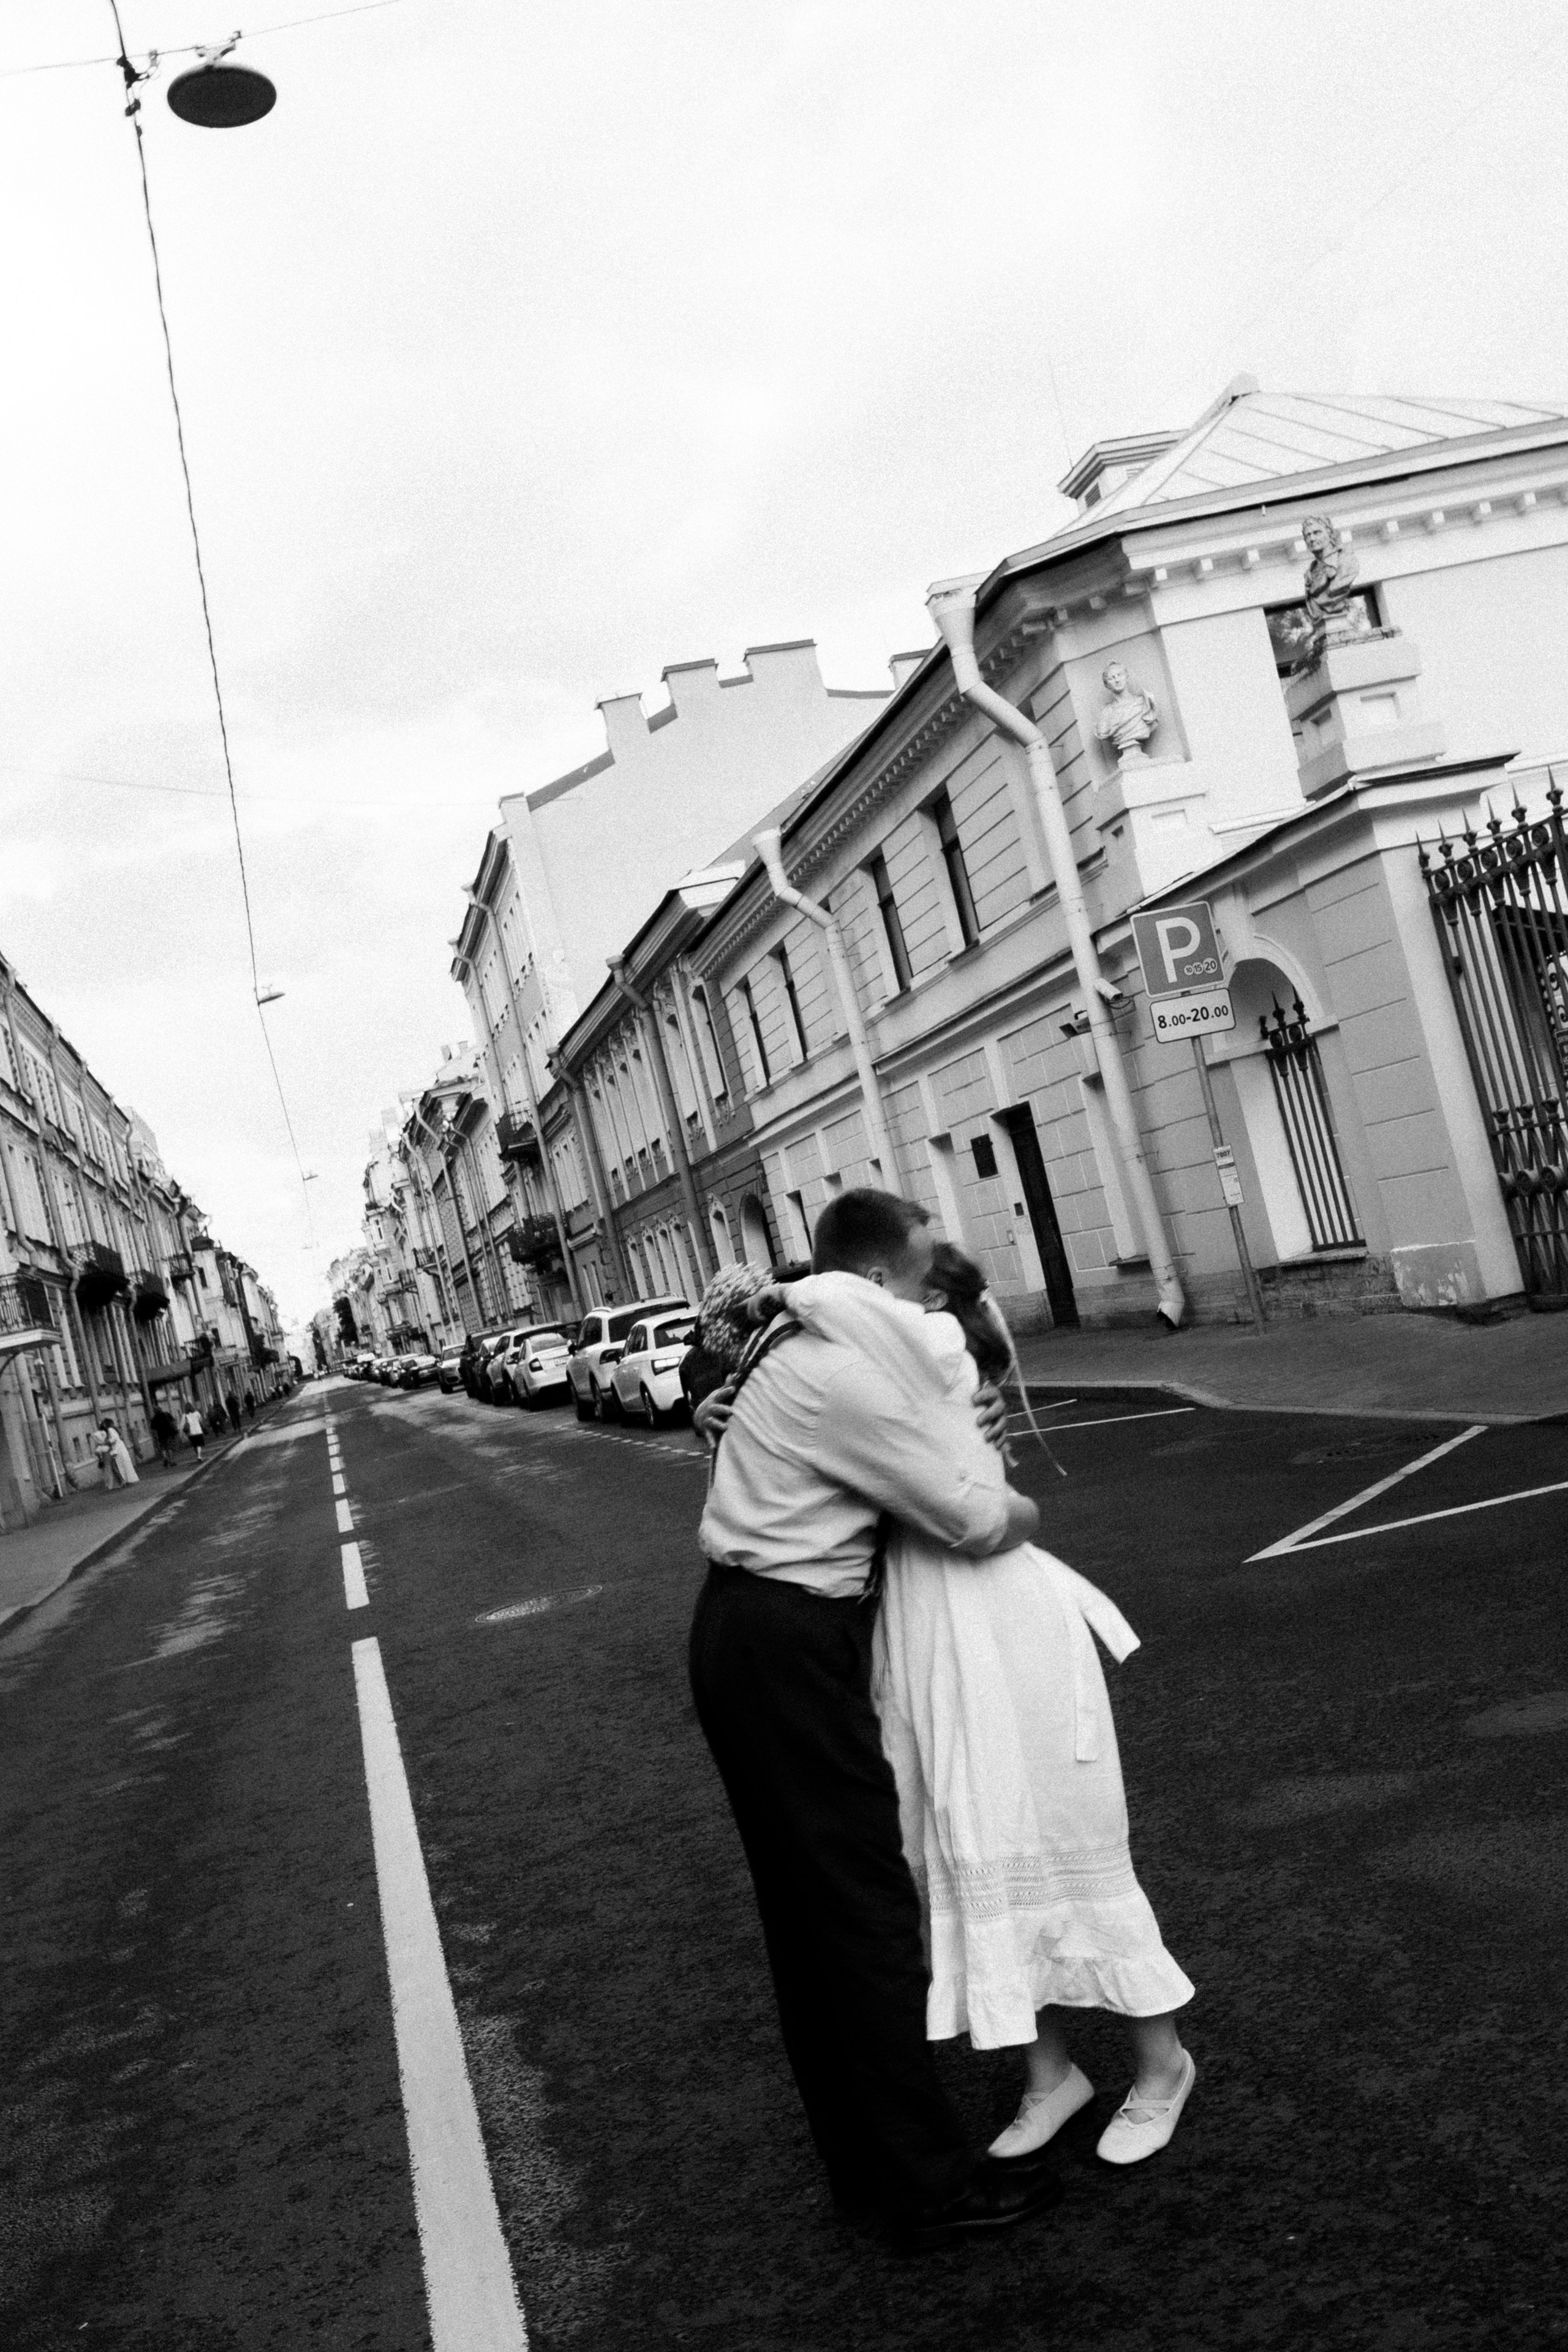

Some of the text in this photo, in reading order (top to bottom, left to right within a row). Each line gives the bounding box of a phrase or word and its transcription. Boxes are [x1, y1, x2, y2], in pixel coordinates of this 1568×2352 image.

[1155, 916, 1200, 983] P
[1194, 963, 1202, 972] 15
[1204, 961, 1216, 971] 20
[1158, 1005, 1229, 1029] 8.00-20.00
